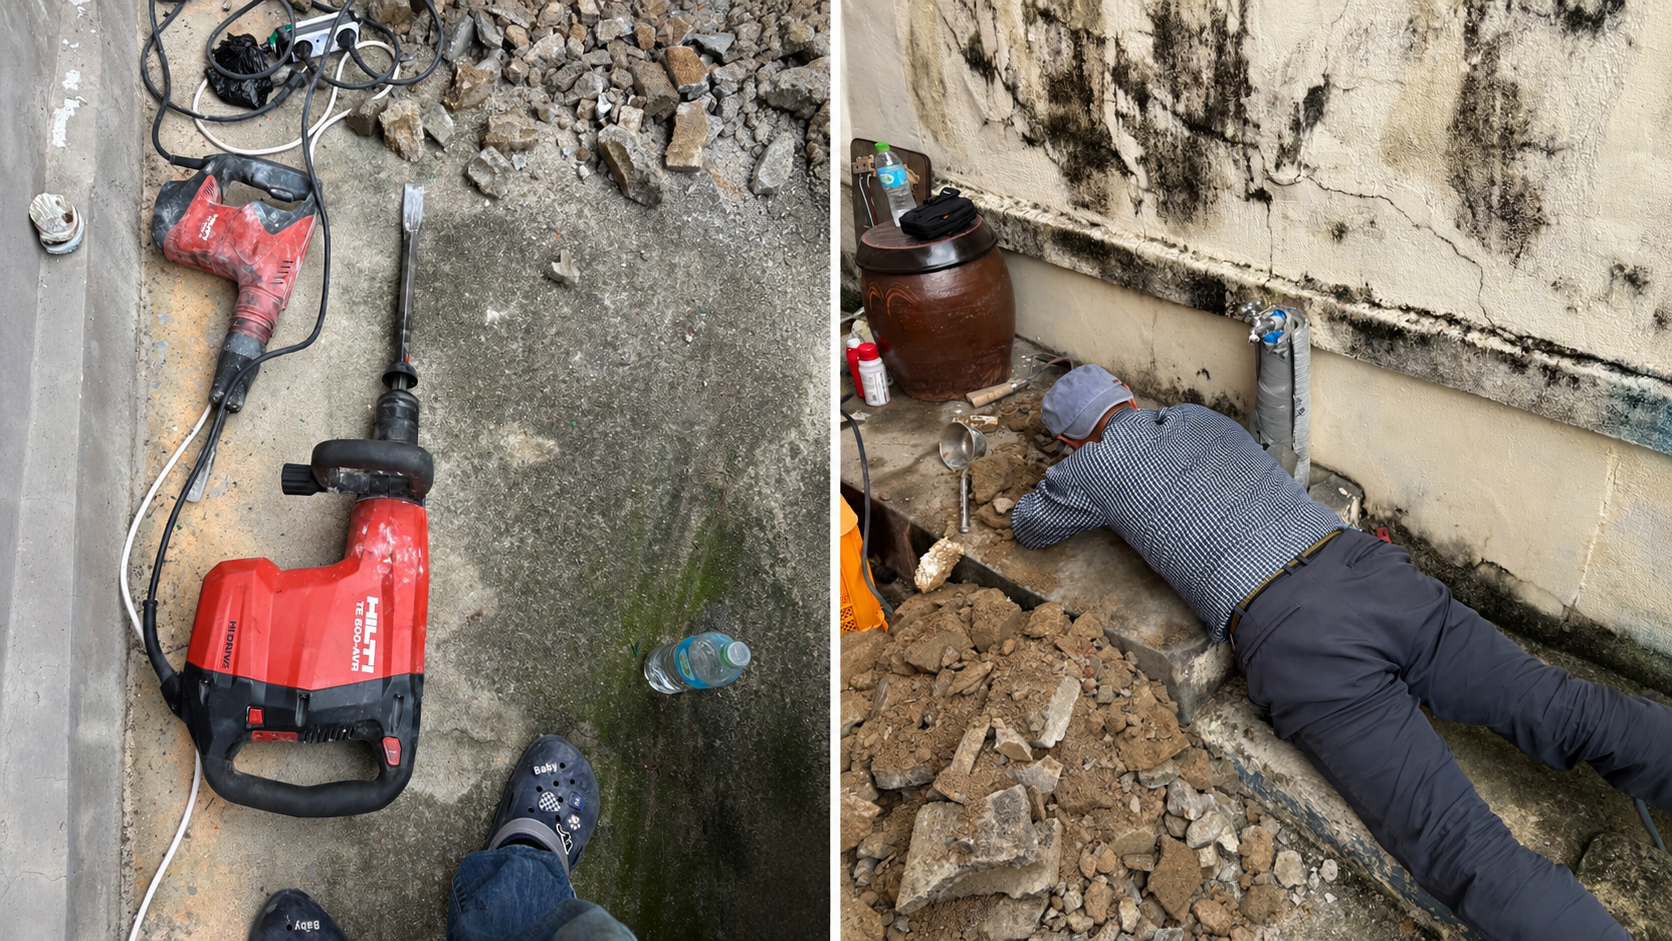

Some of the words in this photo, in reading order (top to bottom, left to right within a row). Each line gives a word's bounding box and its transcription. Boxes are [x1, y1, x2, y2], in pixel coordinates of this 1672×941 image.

[355, 601, 364, 615] TE
[361, 596, 379, 673] HILTI
[294, 920, 320, 930] Baby
